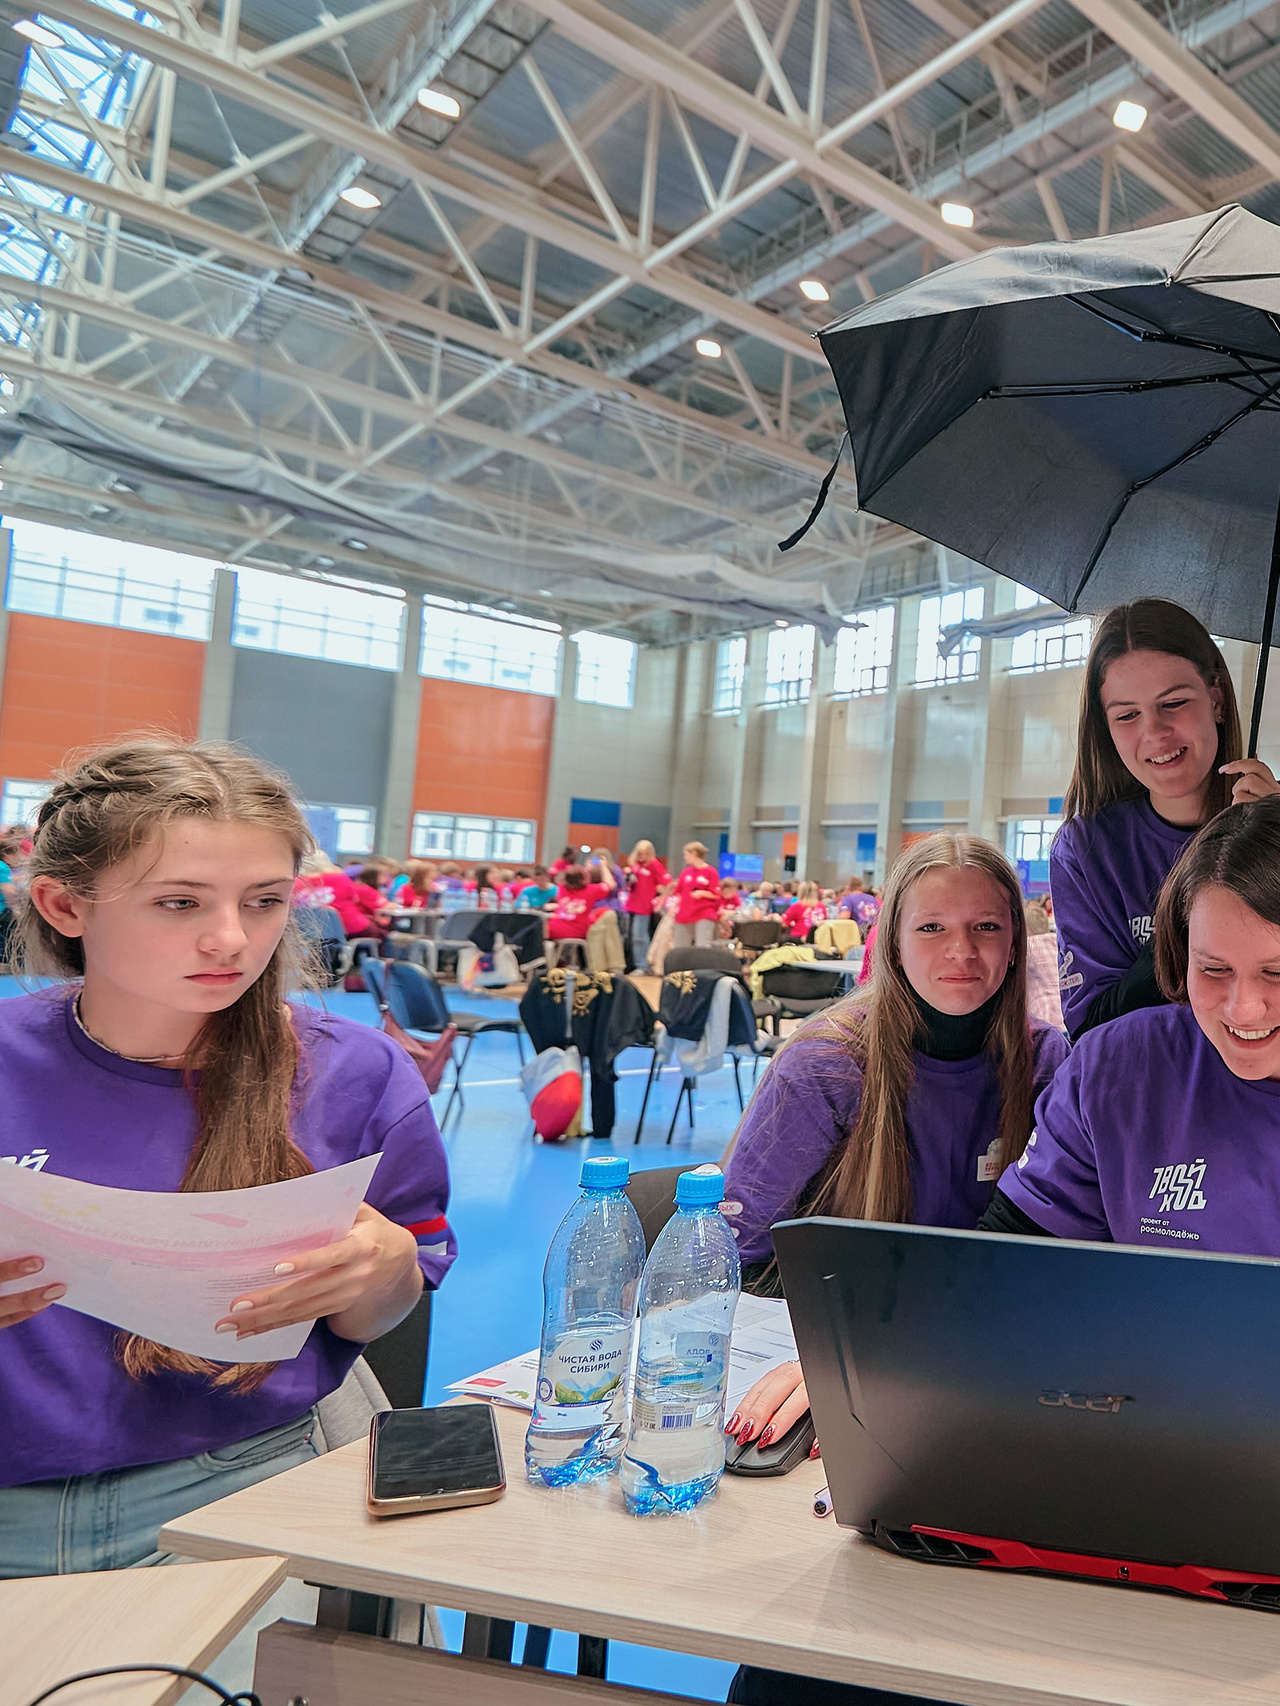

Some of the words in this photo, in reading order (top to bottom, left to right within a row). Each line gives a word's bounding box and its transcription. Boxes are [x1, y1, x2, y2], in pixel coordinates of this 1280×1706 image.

[1148, 1158, 1207, 1199] ТВОЙ
[1158, 1188, 1208, 1213] ХОД
[558, 1355, 595, 1364] ЧИСТАЯ
[598, 1349, 622, 1362] ВОДА
[570, 1361, 610, 1374] СИБИРИ
